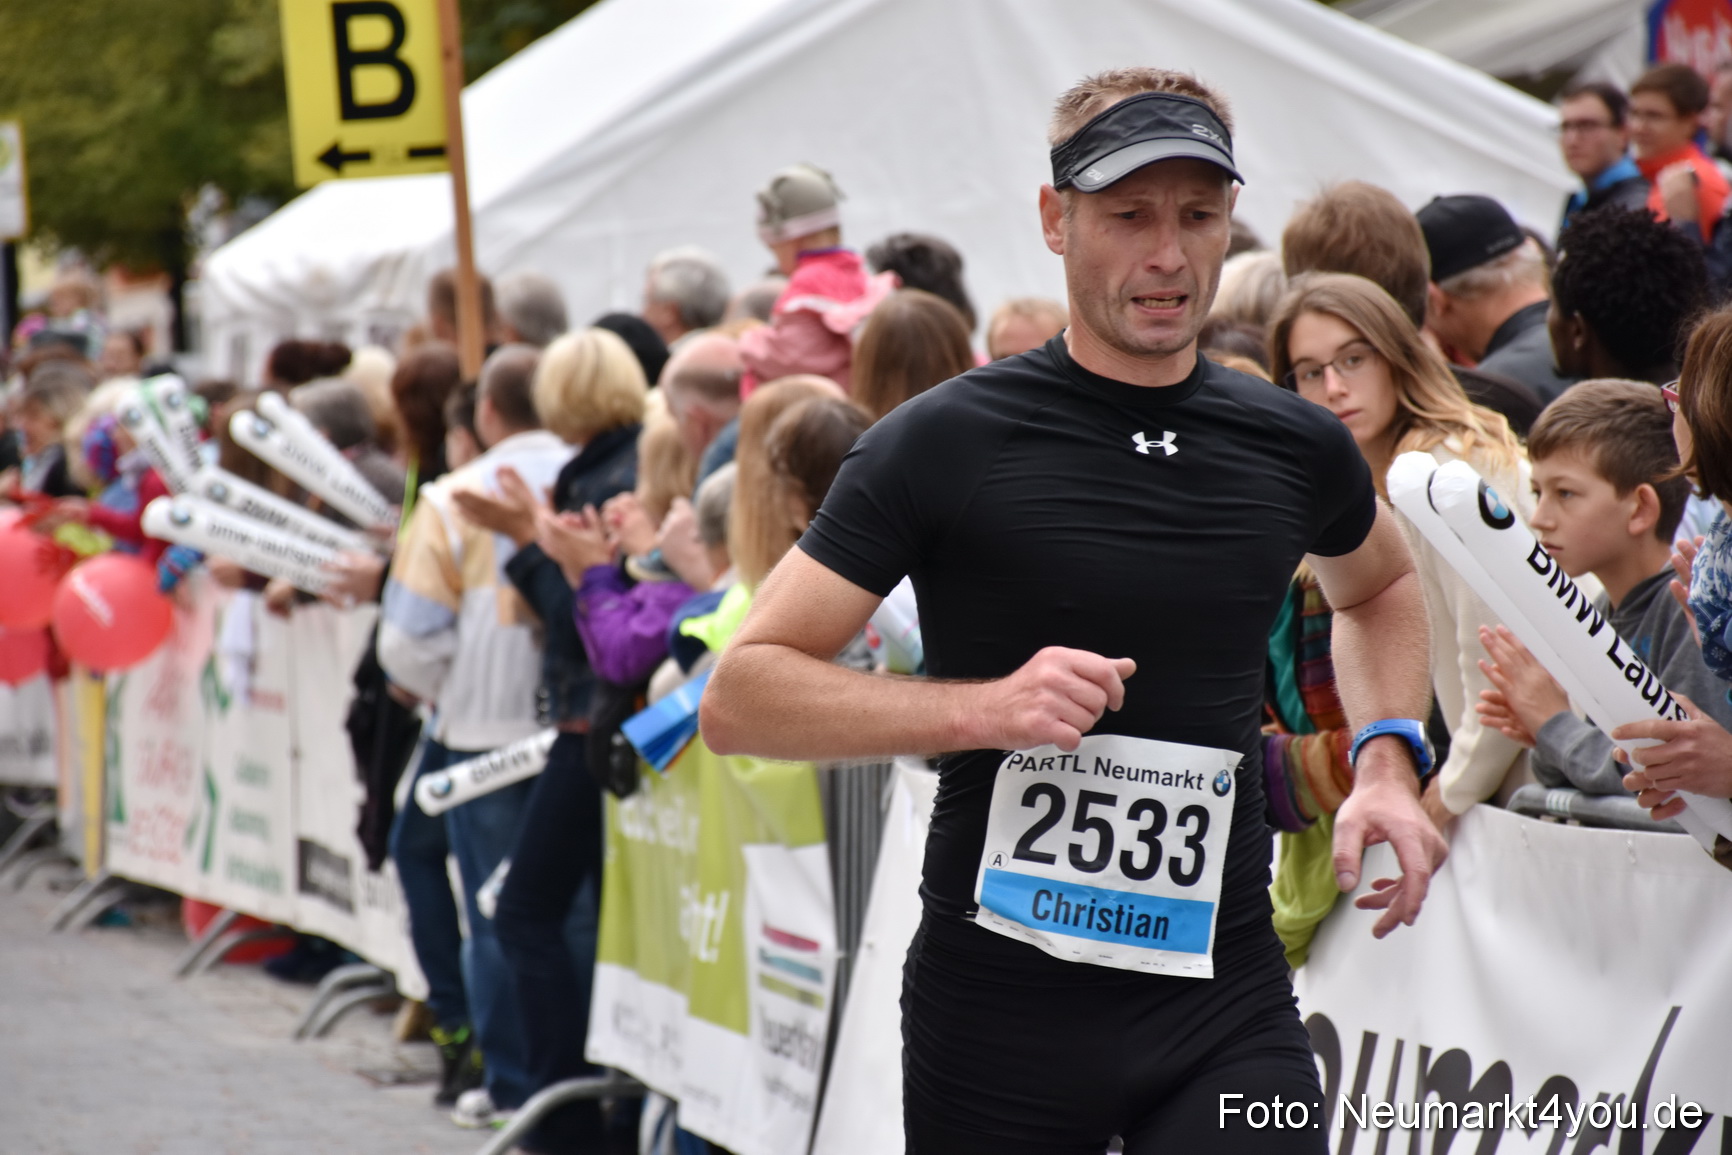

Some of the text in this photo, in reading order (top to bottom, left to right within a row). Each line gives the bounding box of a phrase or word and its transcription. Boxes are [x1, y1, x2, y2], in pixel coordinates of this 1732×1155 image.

[332, 1, 416, 121] B
[1527, 540, 1689, 721] BMW Laufs
[1006, 753, 1087, 774] PARTL
[1094, 756, 1205, 791] Neumarkt
[992, 853, 1003, 867] A
[1012, 782, 1210, 888] 2533
[1031, 889, 1170, 942] Christian
